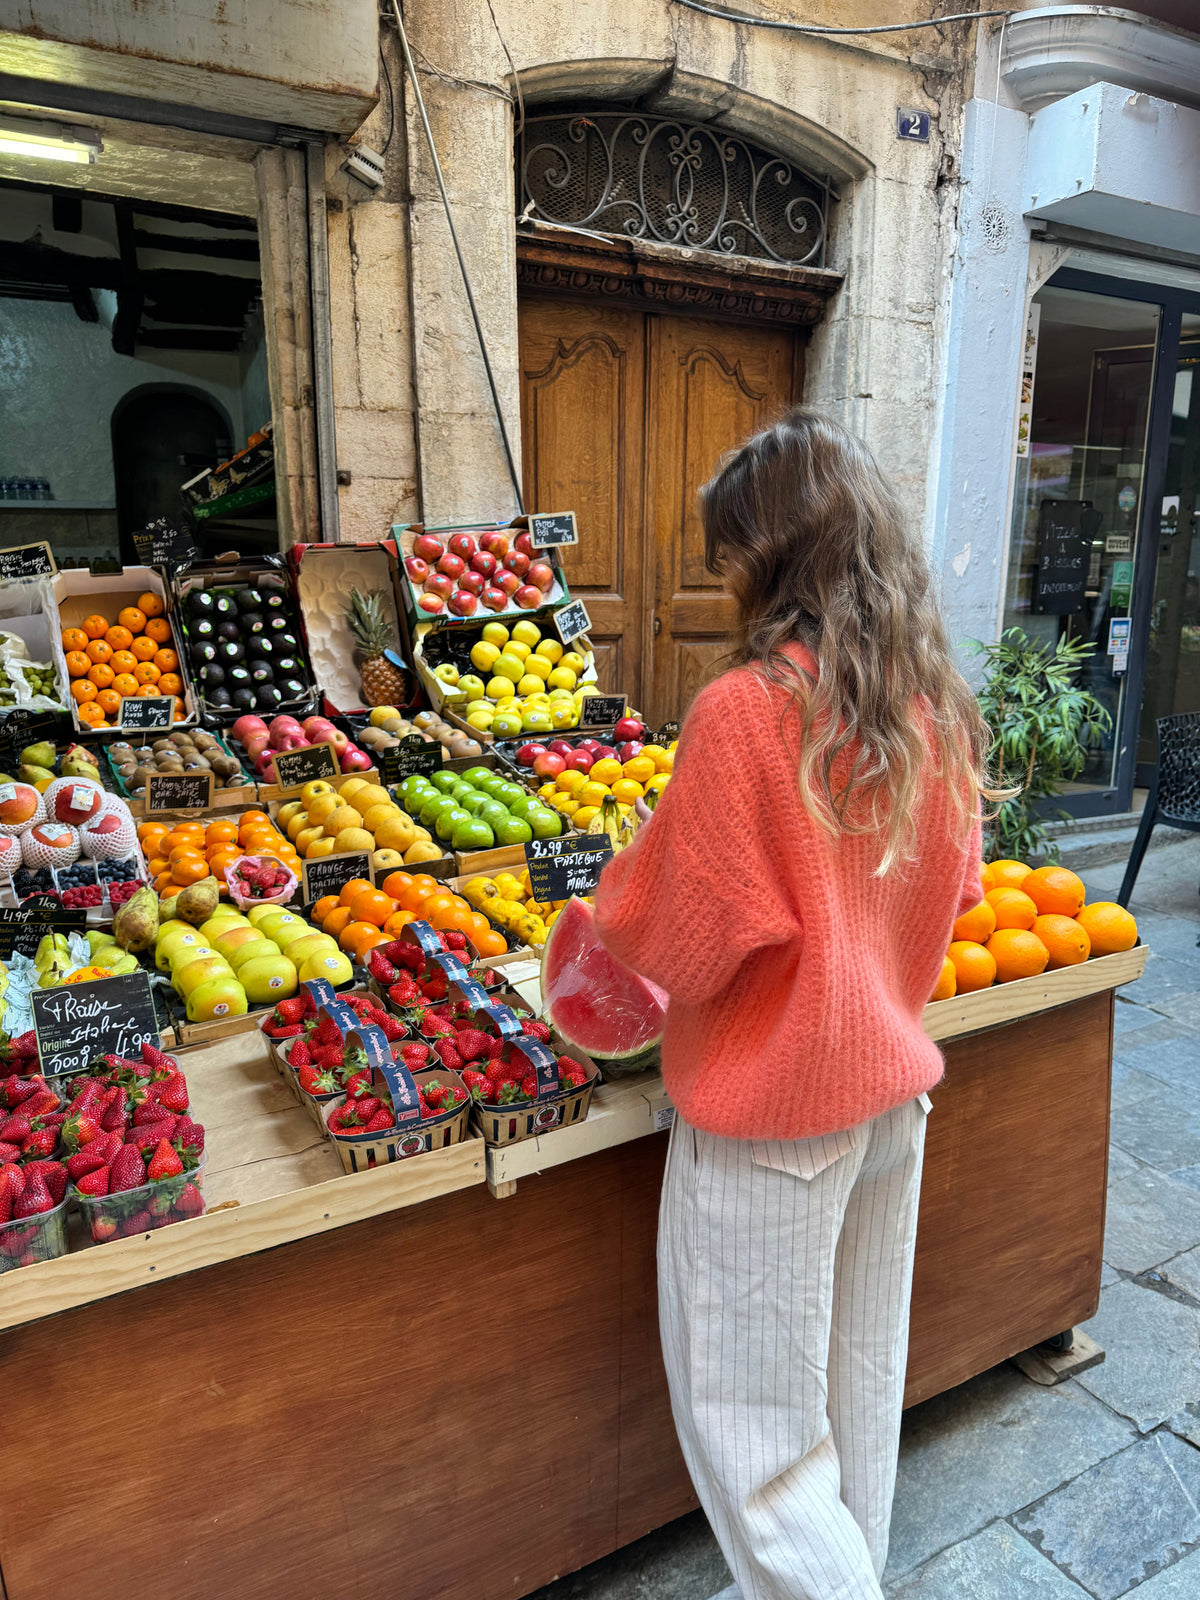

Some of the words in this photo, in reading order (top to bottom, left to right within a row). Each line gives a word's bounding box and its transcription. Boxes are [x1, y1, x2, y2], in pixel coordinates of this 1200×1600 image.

[909, 114, 920, 135] 2
[1108, 539, 1129, 549] OUVERT
[554, 852, 604, 868] PASTEQUE
[39, 897, 57, 909] 1kg
[42, 1037, 72, 1053] Origine
